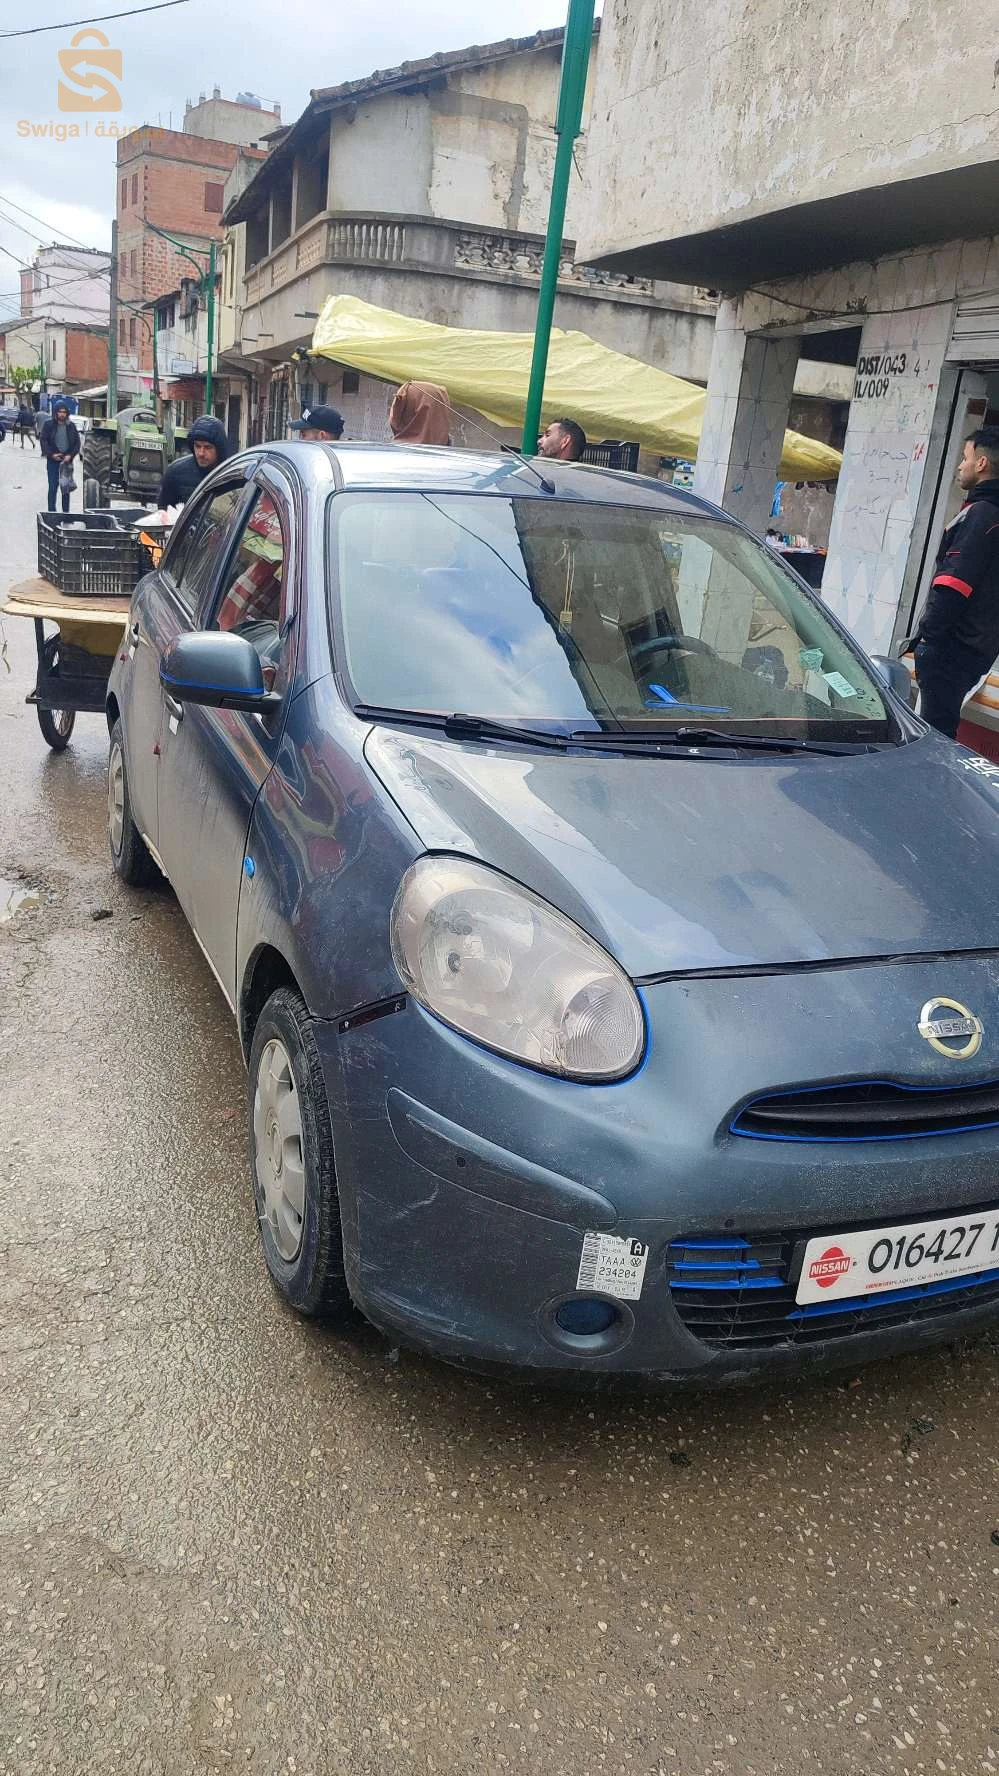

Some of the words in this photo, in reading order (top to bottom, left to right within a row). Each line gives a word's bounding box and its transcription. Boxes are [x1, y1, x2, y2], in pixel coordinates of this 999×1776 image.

[857, 353, 907, 375] DIST/043
[634, 1241, 643, 1255] A
[868, 1223, 986, 1273] 016427
[601, 1255, 625, 1267] TAAA
[810, 1259, 849, 1277] NISSAN
[599, 1266, 636, 1279] 234204
